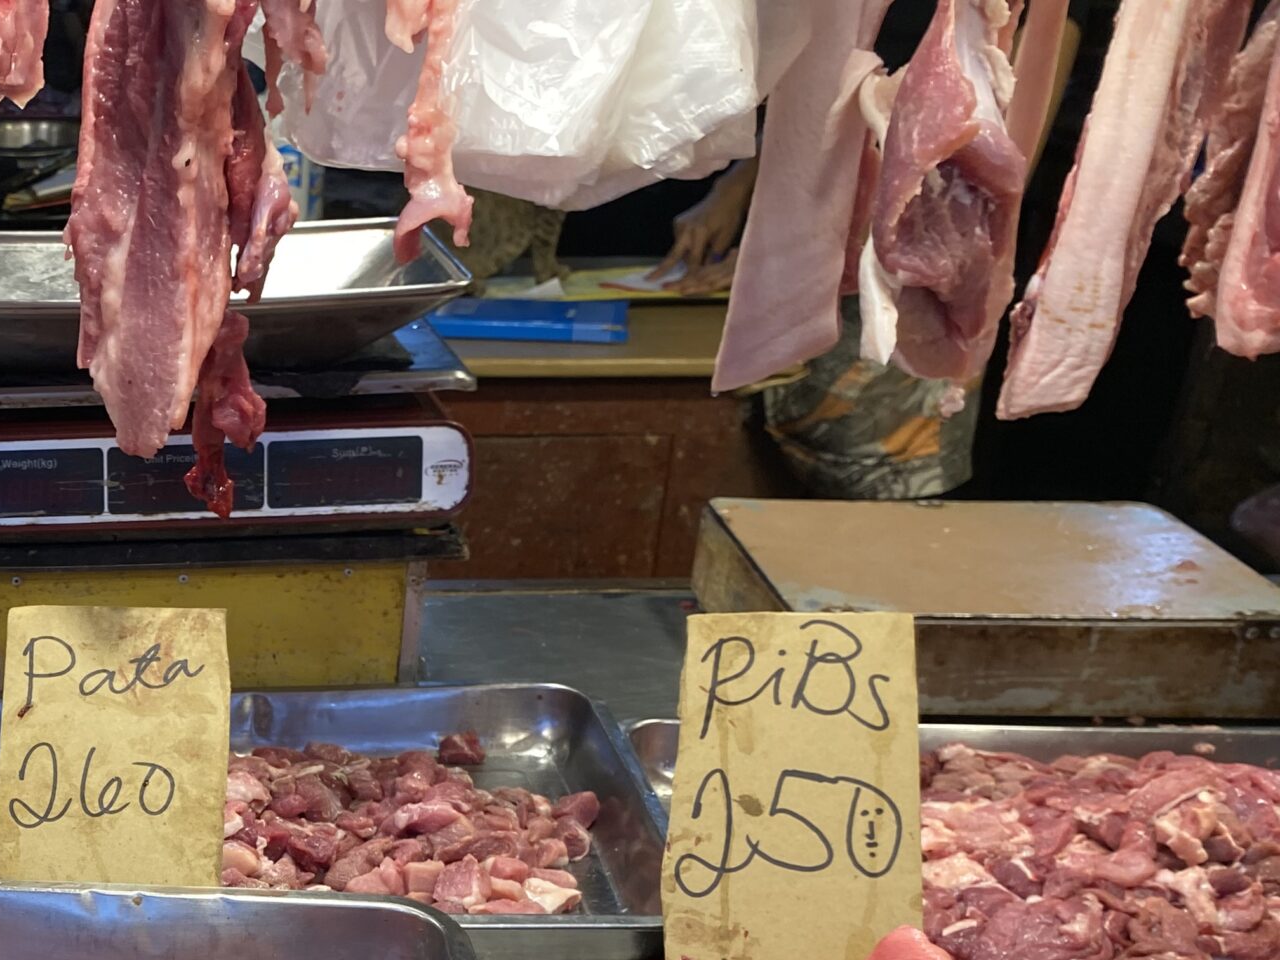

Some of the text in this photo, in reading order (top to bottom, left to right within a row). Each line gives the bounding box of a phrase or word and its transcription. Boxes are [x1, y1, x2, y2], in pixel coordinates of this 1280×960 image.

[1, 457, 58, 470] Weight(kg)
[22, 635, 206, 708] Pata
[8, 741, 176, 830] 260
[674, 767, 903, 899] 250
